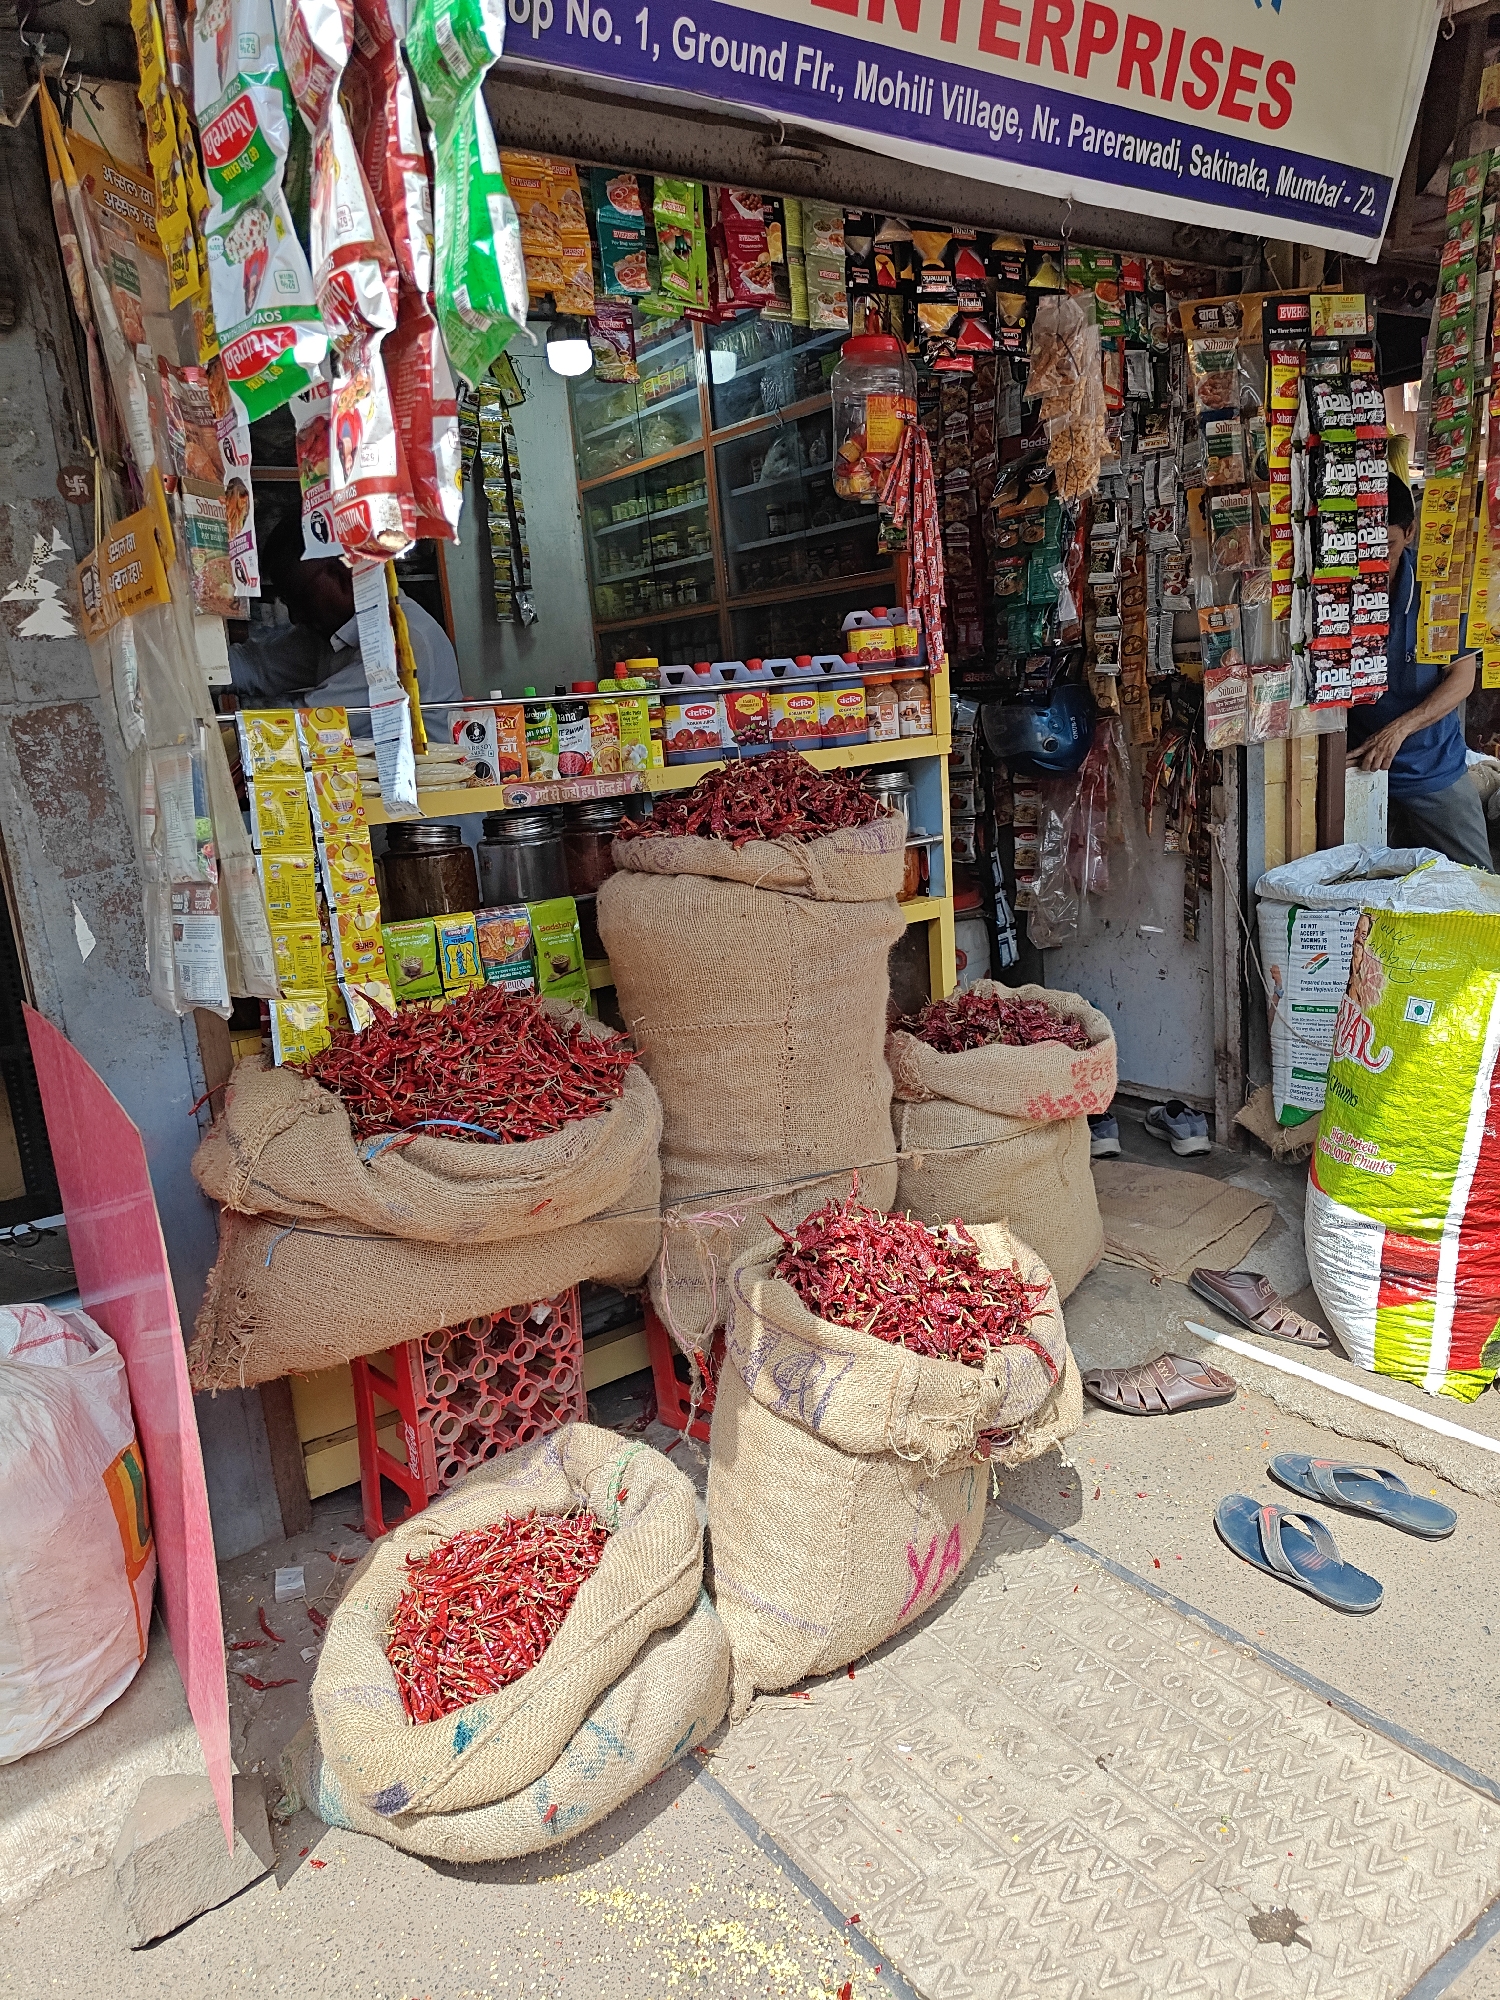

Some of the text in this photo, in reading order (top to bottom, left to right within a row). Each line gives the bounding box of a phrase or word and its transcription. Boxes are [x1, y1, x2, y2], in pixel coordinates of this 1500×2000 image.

[566, 0, 622, 46] No.
[635, 7, 660, 62] 1,
[672, 17, 784, 82] Ground
[794, 45, 844, 103] Flr.,
[852, 60, 934, 116] Mohili
[943, 78, 1023, 144] Village,
[1031, 103, 1061, 146] Nr.
[1067, 113, 1183, 180] Parerawadi,
[1189, 145, 1270, 199] Sakinaka,
[1275, 165, 1342, 210] Mumbai
[1352, 185, 1377, 218] 72.
[203, 101, 254, 160] Nutrela
[142, 211, 156, 232] रह
[253, 309, 283, 325] SOYA
[1280, 305, 1309, 319] EVERE
[225, 330, 286, 375] Nutrela
[1204, 339, 1234, 350] Suhana
[1354, 349, 1372, 359] Suhana
[1020, 437, 1051, 449] Badsh
[196, 498, 228, 519] Suhan
[1220, 496, 1248, 508] Suhana
[580, 784, 595, 798] हम
[539, 920, 573, 933] Badshah
[355, 941, 374, 951] GHEE
[1345, 1133, 1378, 1155] Protein
[1352, 1152, 1395, 1175] Chunks
[404, 1421, 420, 1480] Coca-Cola
